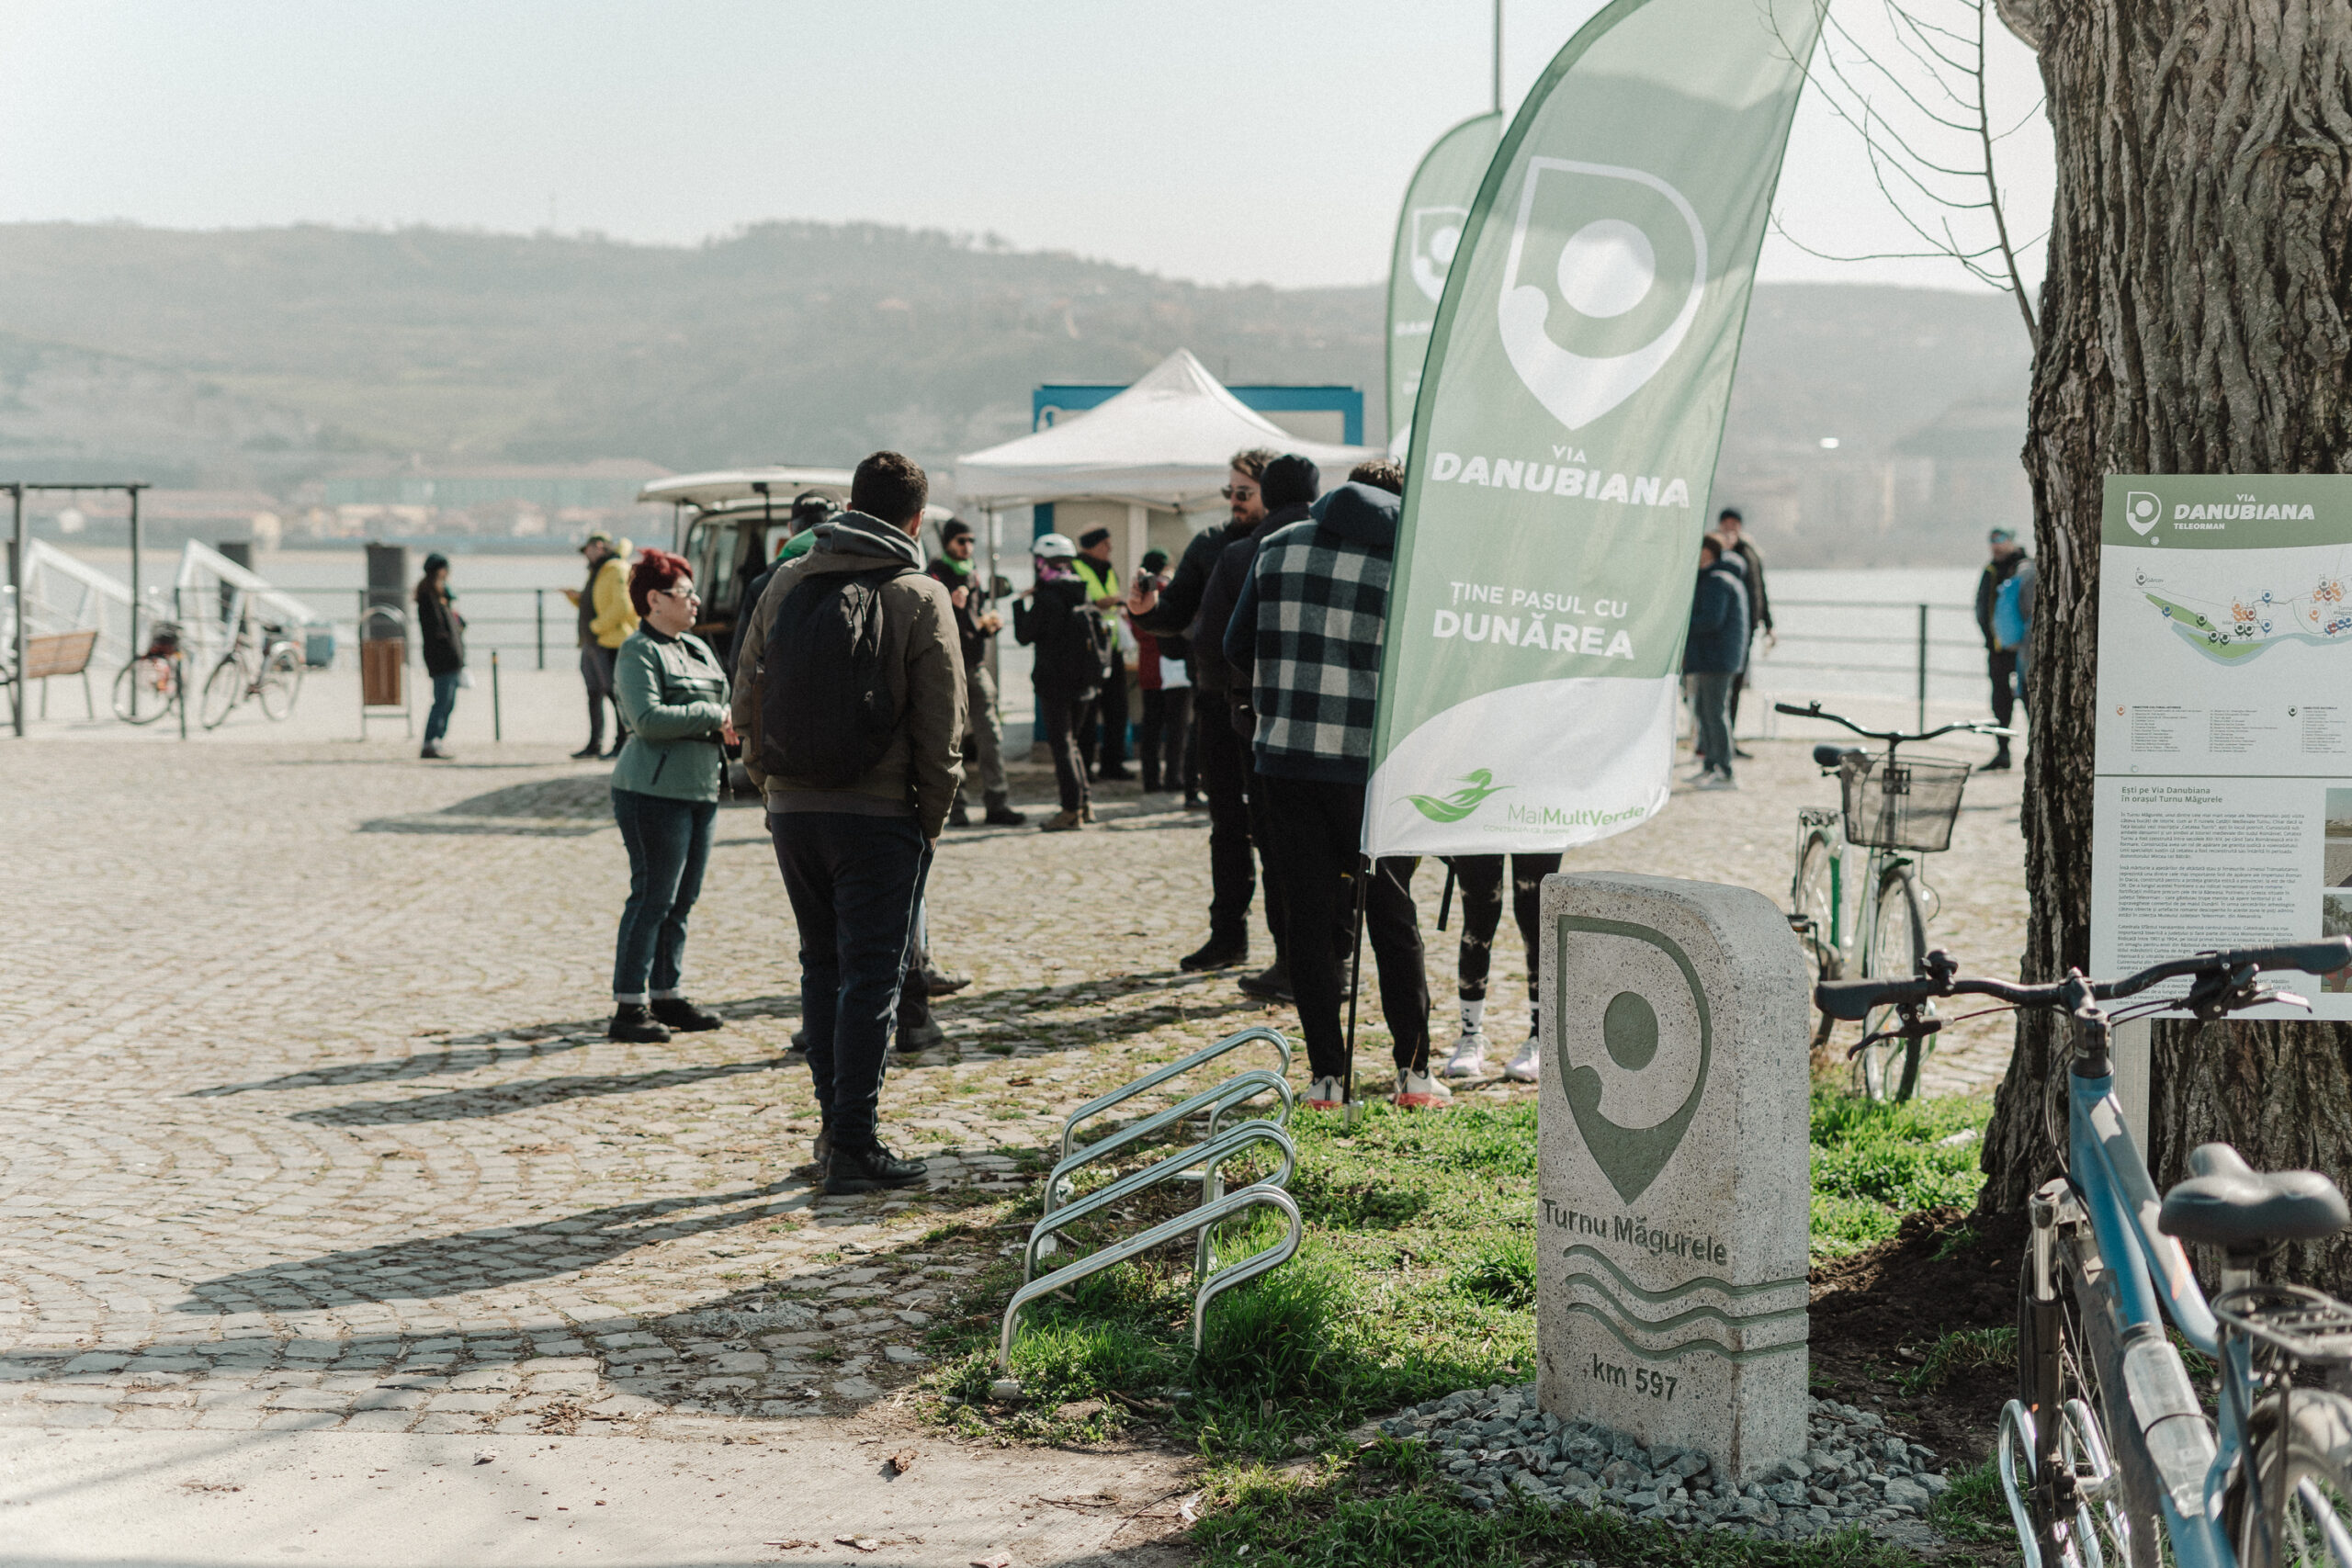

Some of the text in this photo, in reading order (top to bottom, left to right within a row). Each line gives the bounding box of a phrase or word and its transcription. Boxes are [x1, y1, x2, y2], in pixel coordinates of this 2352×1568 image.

[1552, 446, 1587, 463] VIA
[1431, 452, 1690, 508] DANUBIANA
[2236, 493, 2256, 502] VIA
[2174, 504, 2314, 520] DANUBIANA
[1450, 582, 1628, 619] ȚINE PASUL CU
[1432, 609, 1635, 660] DUNĂREA
[2121, 786, 2136, 795] Ești
[2152, 786, 2164, 795] Via
[2166, 786, 2211, 795] Danubiana
[2185, 795, 2223, 805] Măgurele
[1542, 1198, 1728, 1266] Turnu Măgurele
[1592, 1353, 1678, 1402] km 597
